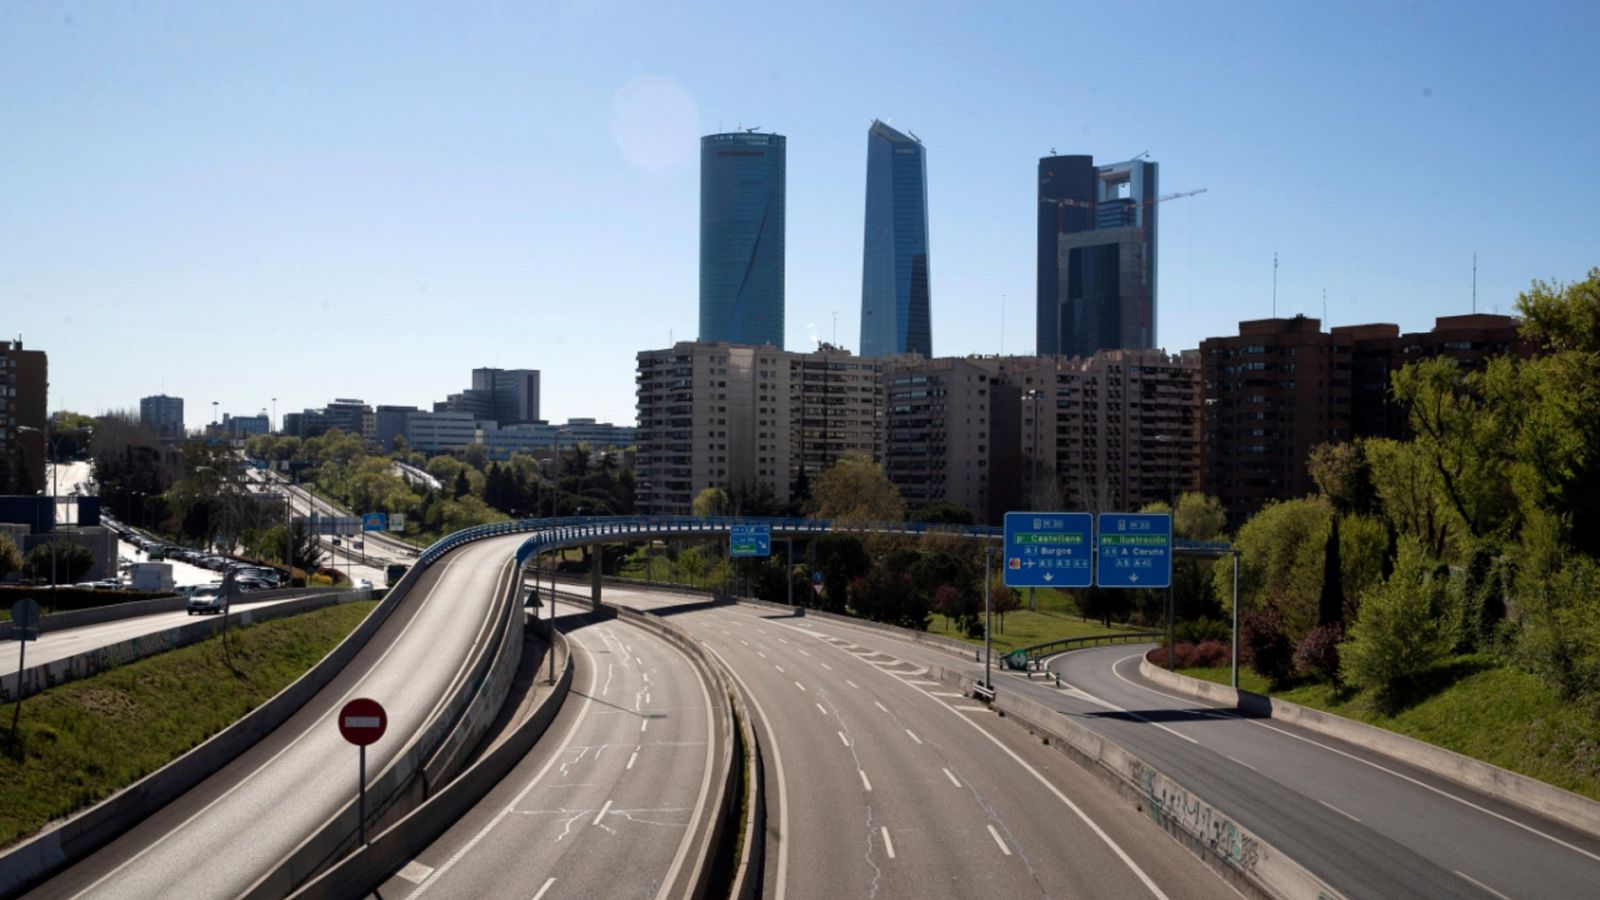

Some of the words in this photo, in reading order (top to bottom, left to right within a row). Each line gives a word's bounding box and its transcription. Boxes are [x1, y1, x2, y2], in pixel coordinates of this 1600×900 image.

[1031, 534, 1081, 542] Castellana
[1041, 547, 1072, 556] Burgos
[1121, 547, 1128, 555] A
